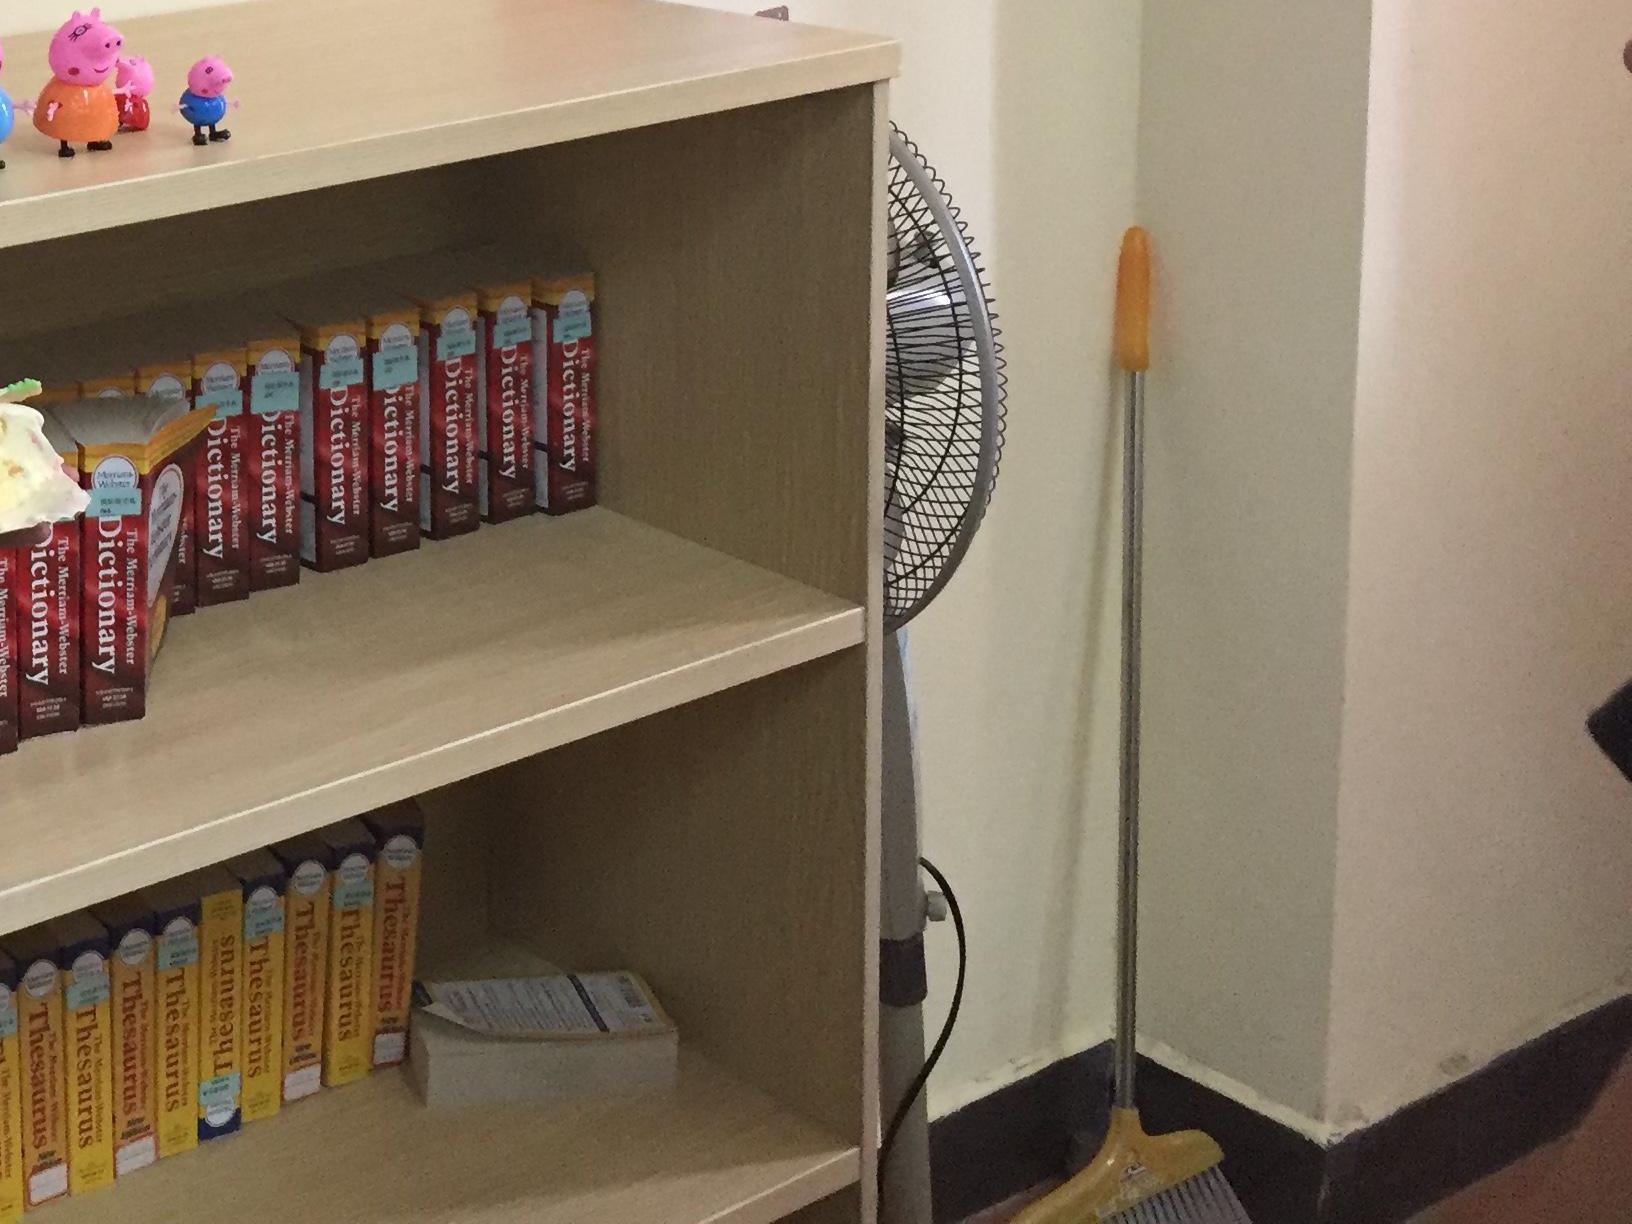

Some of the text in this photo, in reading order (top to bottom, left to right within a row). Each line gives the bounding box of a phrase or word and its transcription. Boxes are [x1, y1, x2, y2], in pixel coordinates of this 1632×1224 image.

[326, 386, 350, 525] Dictionary
[442, 356, 464, 494] Dictionary
[499, 344, 519, 480] Dictionary
[559, 338, 580, 473] Dictionary
[202, 418, 229, 559] Dictionary
[58, 536, 70, 675] The Merriam-Webster
[92, 515, 124, 675] Dictionary
[126, 528, 138, 665] The Merriam-Webster
[213, 934, 235, 1077] Thesaurus
[248, 936, 271, 1079] Thesaurus
[292, 901, 317, 1042] Thesaurus
[338, 908, 361, 1042] Thesaurus
[378, 877, 406, 1014] Thesaurus
[29, 1002, 51, 1151] Thesaurus
[76, 1004, 99, 1151] Thesaurus
[123, 970, 144, 1117] Thesaurus
[166, 967, 187, 1114] Thesaurus
